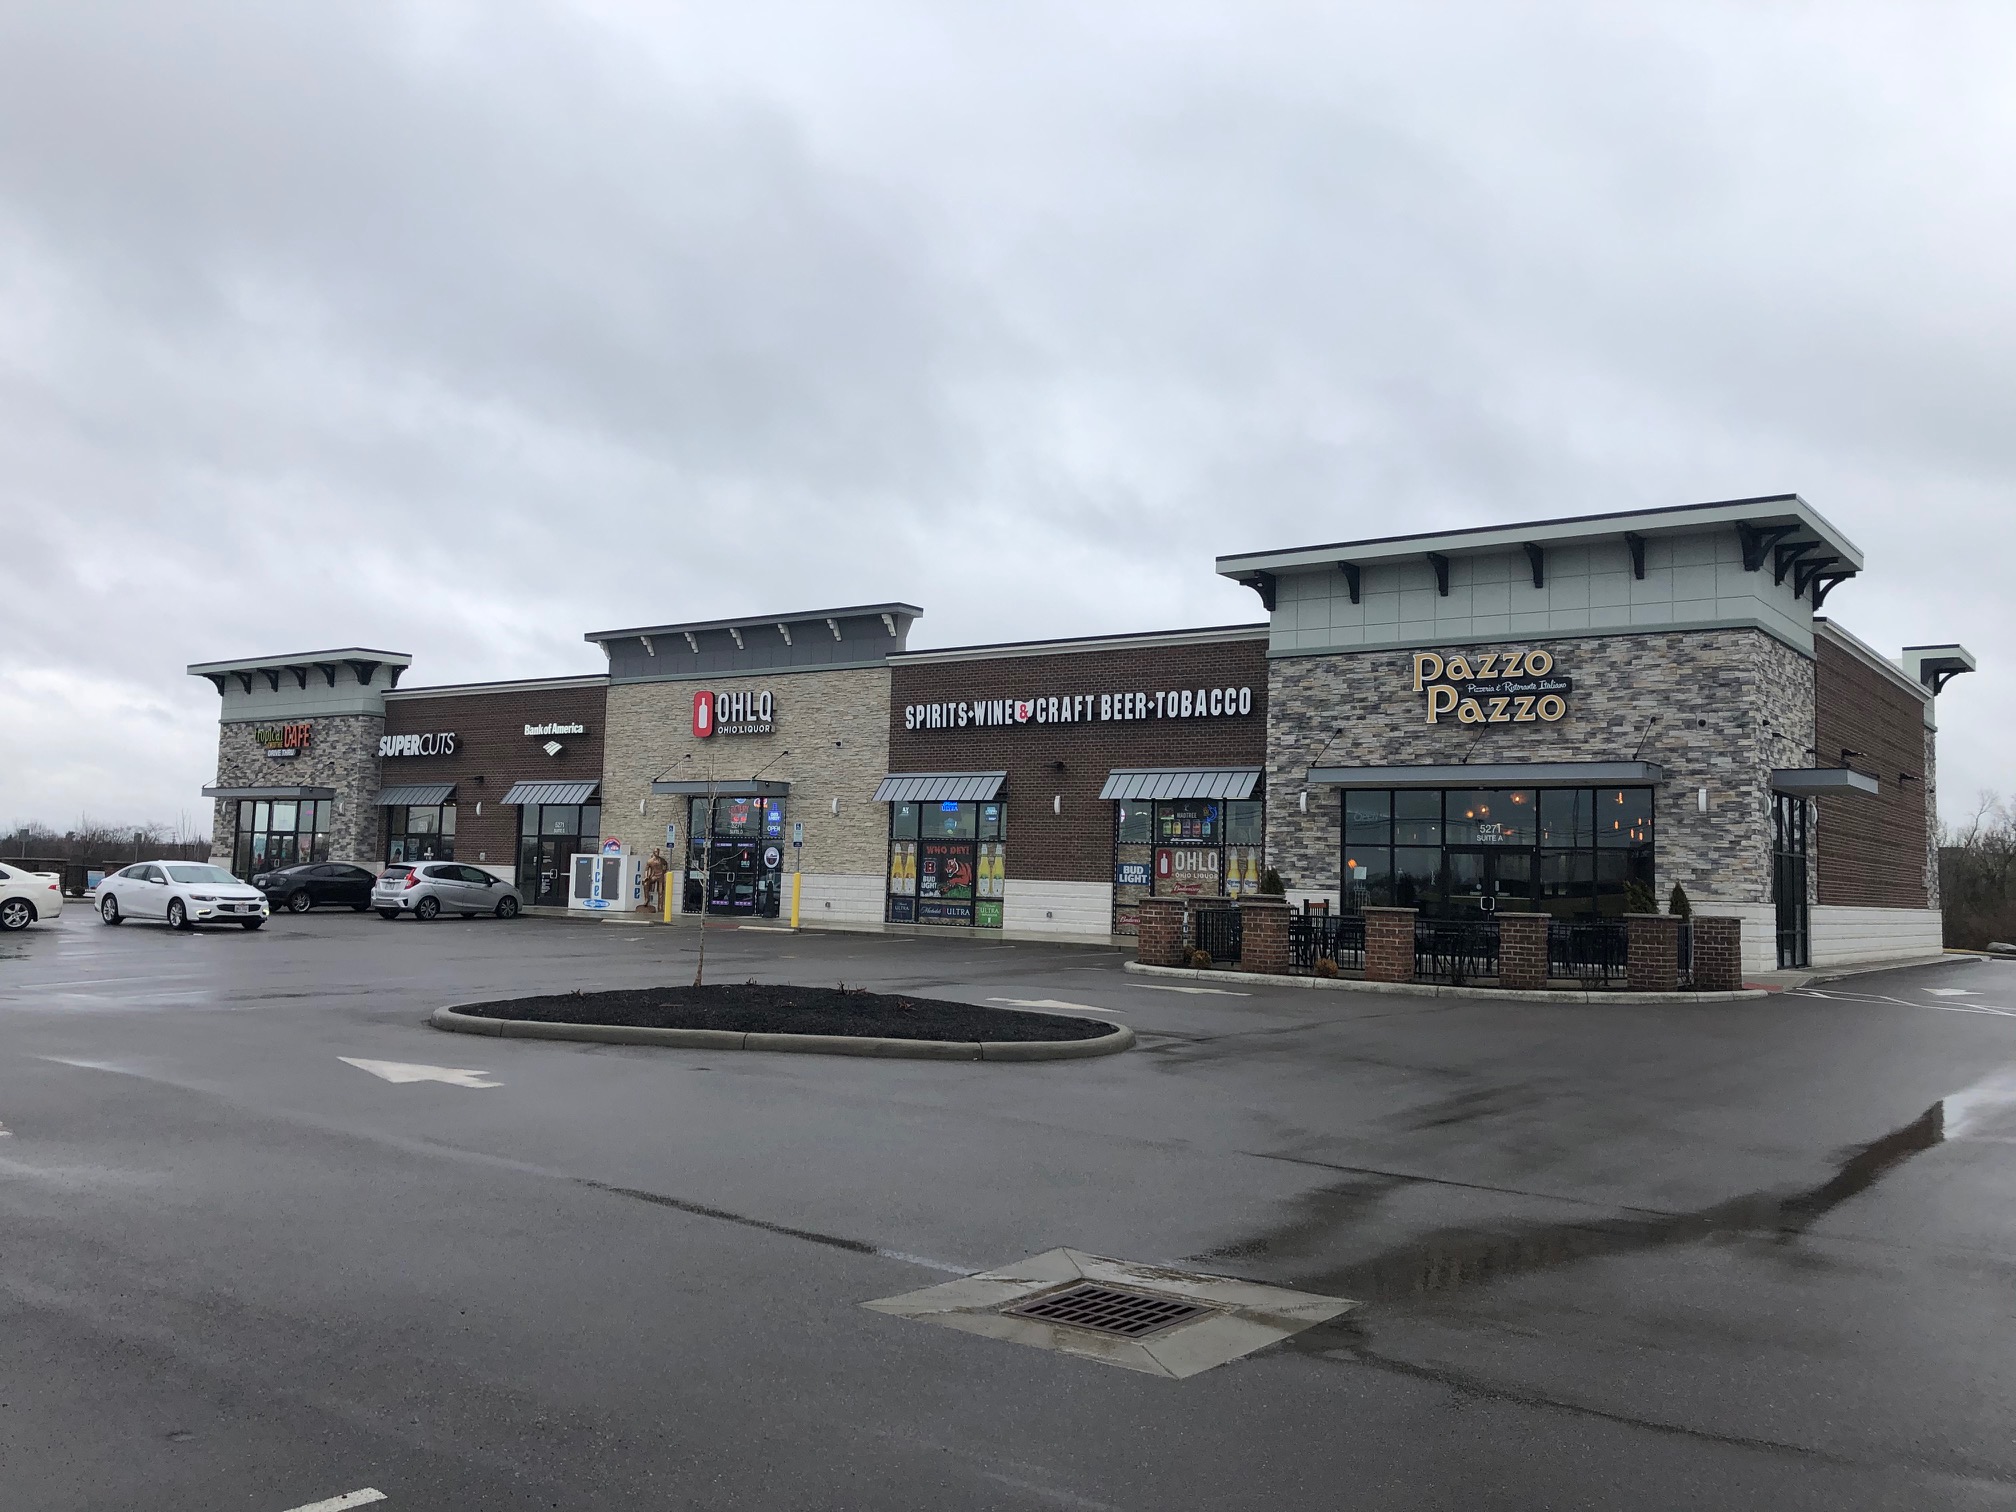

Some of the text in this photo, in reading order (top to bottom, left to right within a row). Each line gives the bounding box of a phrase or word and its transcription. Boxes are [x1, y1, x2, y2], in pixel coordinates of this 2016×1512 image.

[1412, 650, 1553, 691] Pazzo
[717, 690, 772, 722] OHLQ
[905, 702, 967, 730] SPIRITS
[974, 700, 1013, 726] WINE
[1036, 695, 1094, 723] CRAFT
[1101, 692, 1147, 721] BEER
[1155, 687, 1251, 718] TOBACCO
[1426, 684, 1566, 724] Pazzo
[524, 722, 583, 735] Bank of America
[717, 725, 770, 734] OHIO LIQUOR
[284, 724, 311, 748] CAFE
[378, 732, 455, 757] SUPERCUTS
[267, 749, 281, 757] DRIVE
[1479, 824, 1501, 834] 5271
[1476, 834, 1503, 842] SUITE A
[1175, 851, 1218, 872] OHLQ
[1123, 865, 1144, 874] BUD
[1119, 874, 1148, 883] LIGHT
[946, 907, 970, 916] ULTRA
[980, 905, 999, 914] ULTRA
